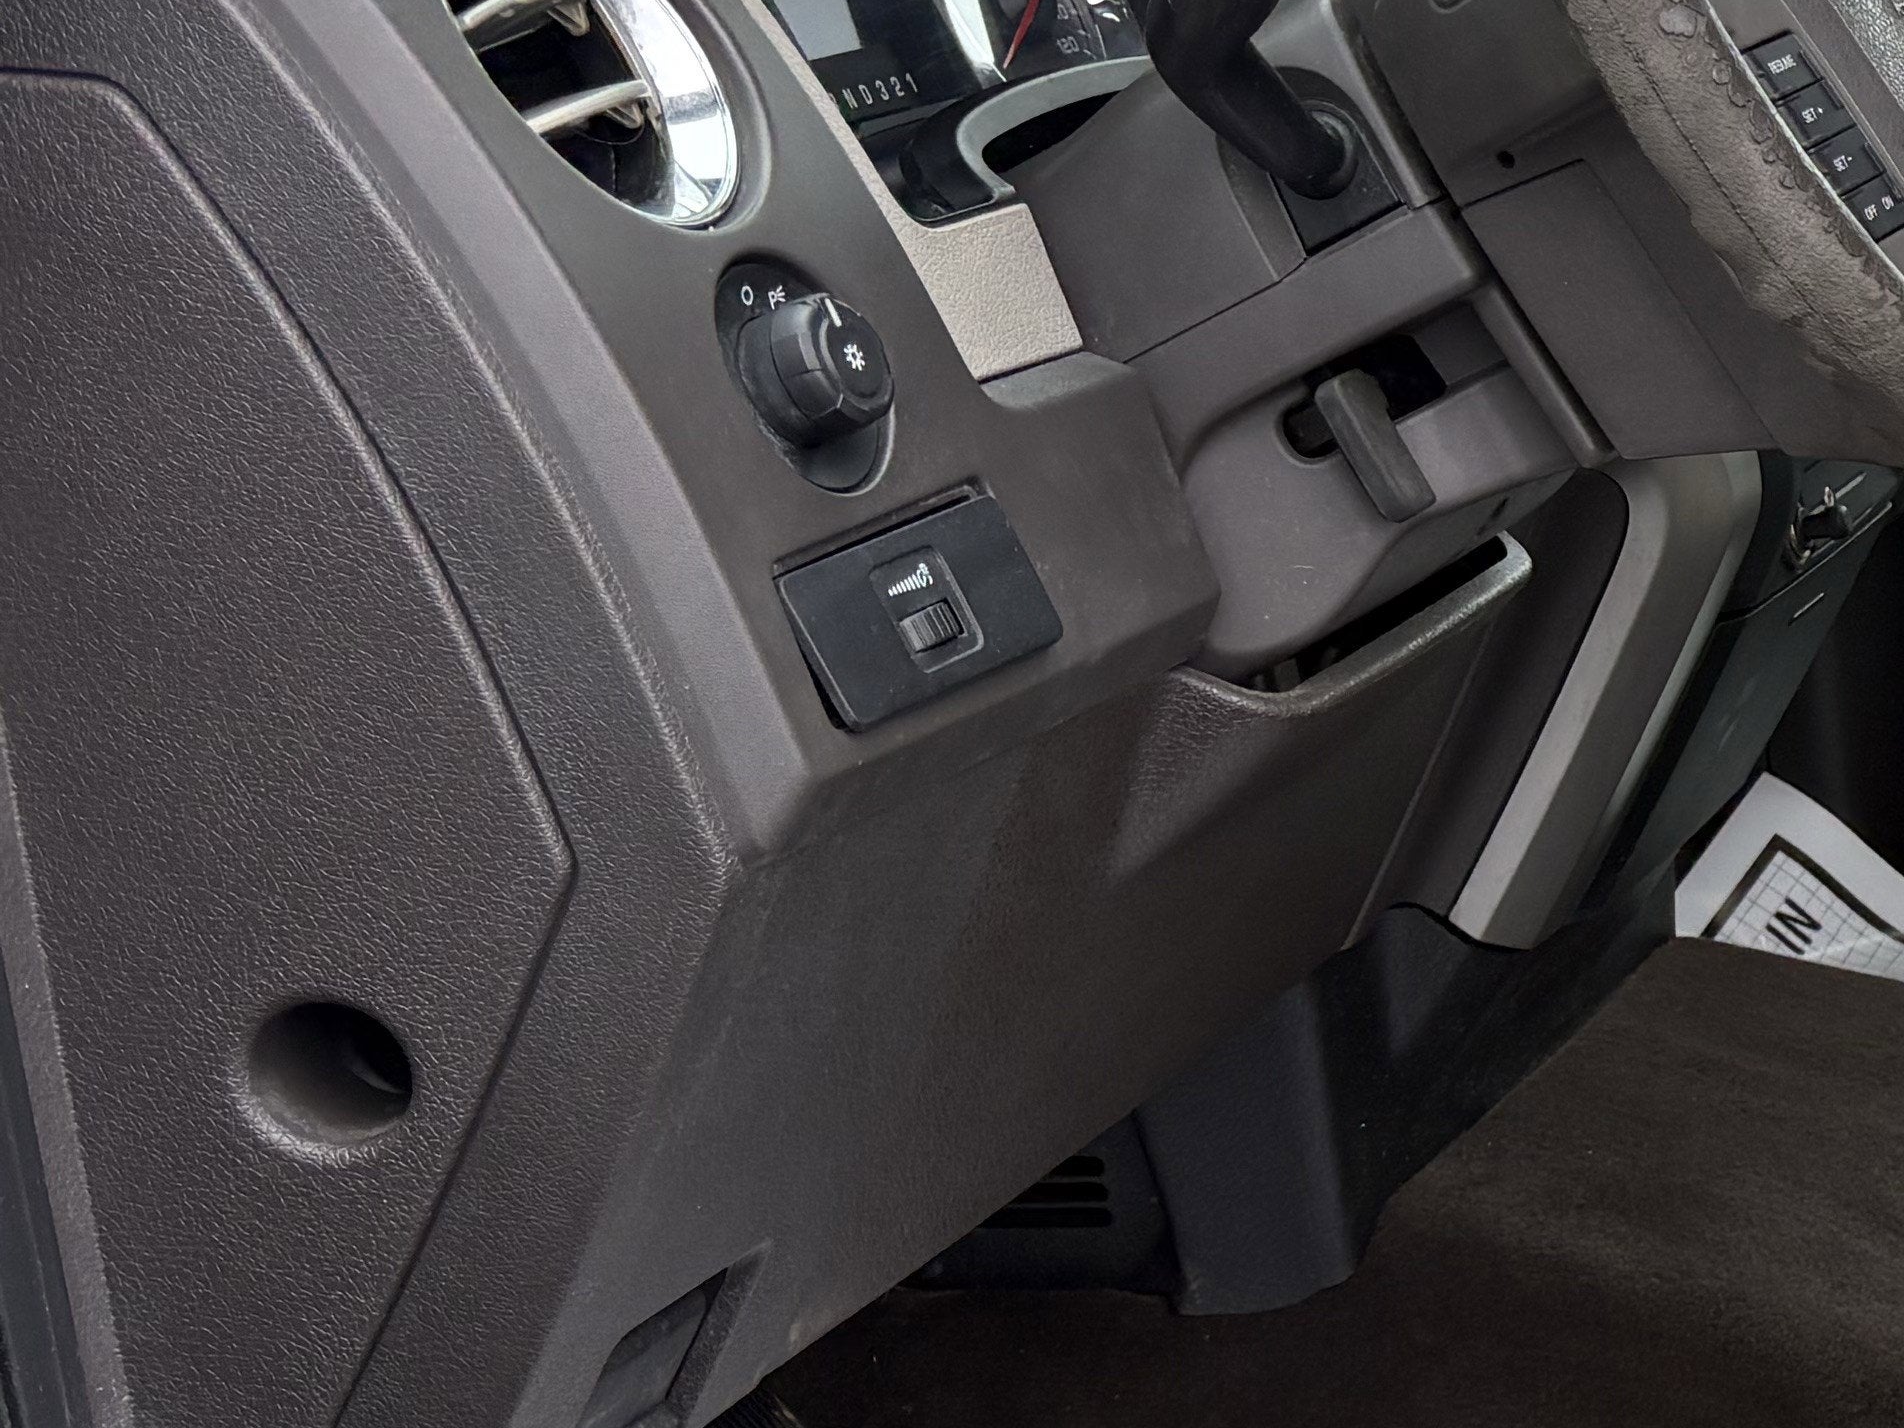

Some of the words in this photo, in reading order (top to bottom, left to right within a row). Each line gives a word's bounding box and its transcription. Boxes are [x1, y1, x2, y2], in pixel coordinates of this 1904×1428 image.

[859, 84, 873, 105] D
[876, 80, 889, 101] 3
[890, 76, 905, 97] 2
[905, 72, 918, 93] 1
[1765, 895, 1822, 956] IN
